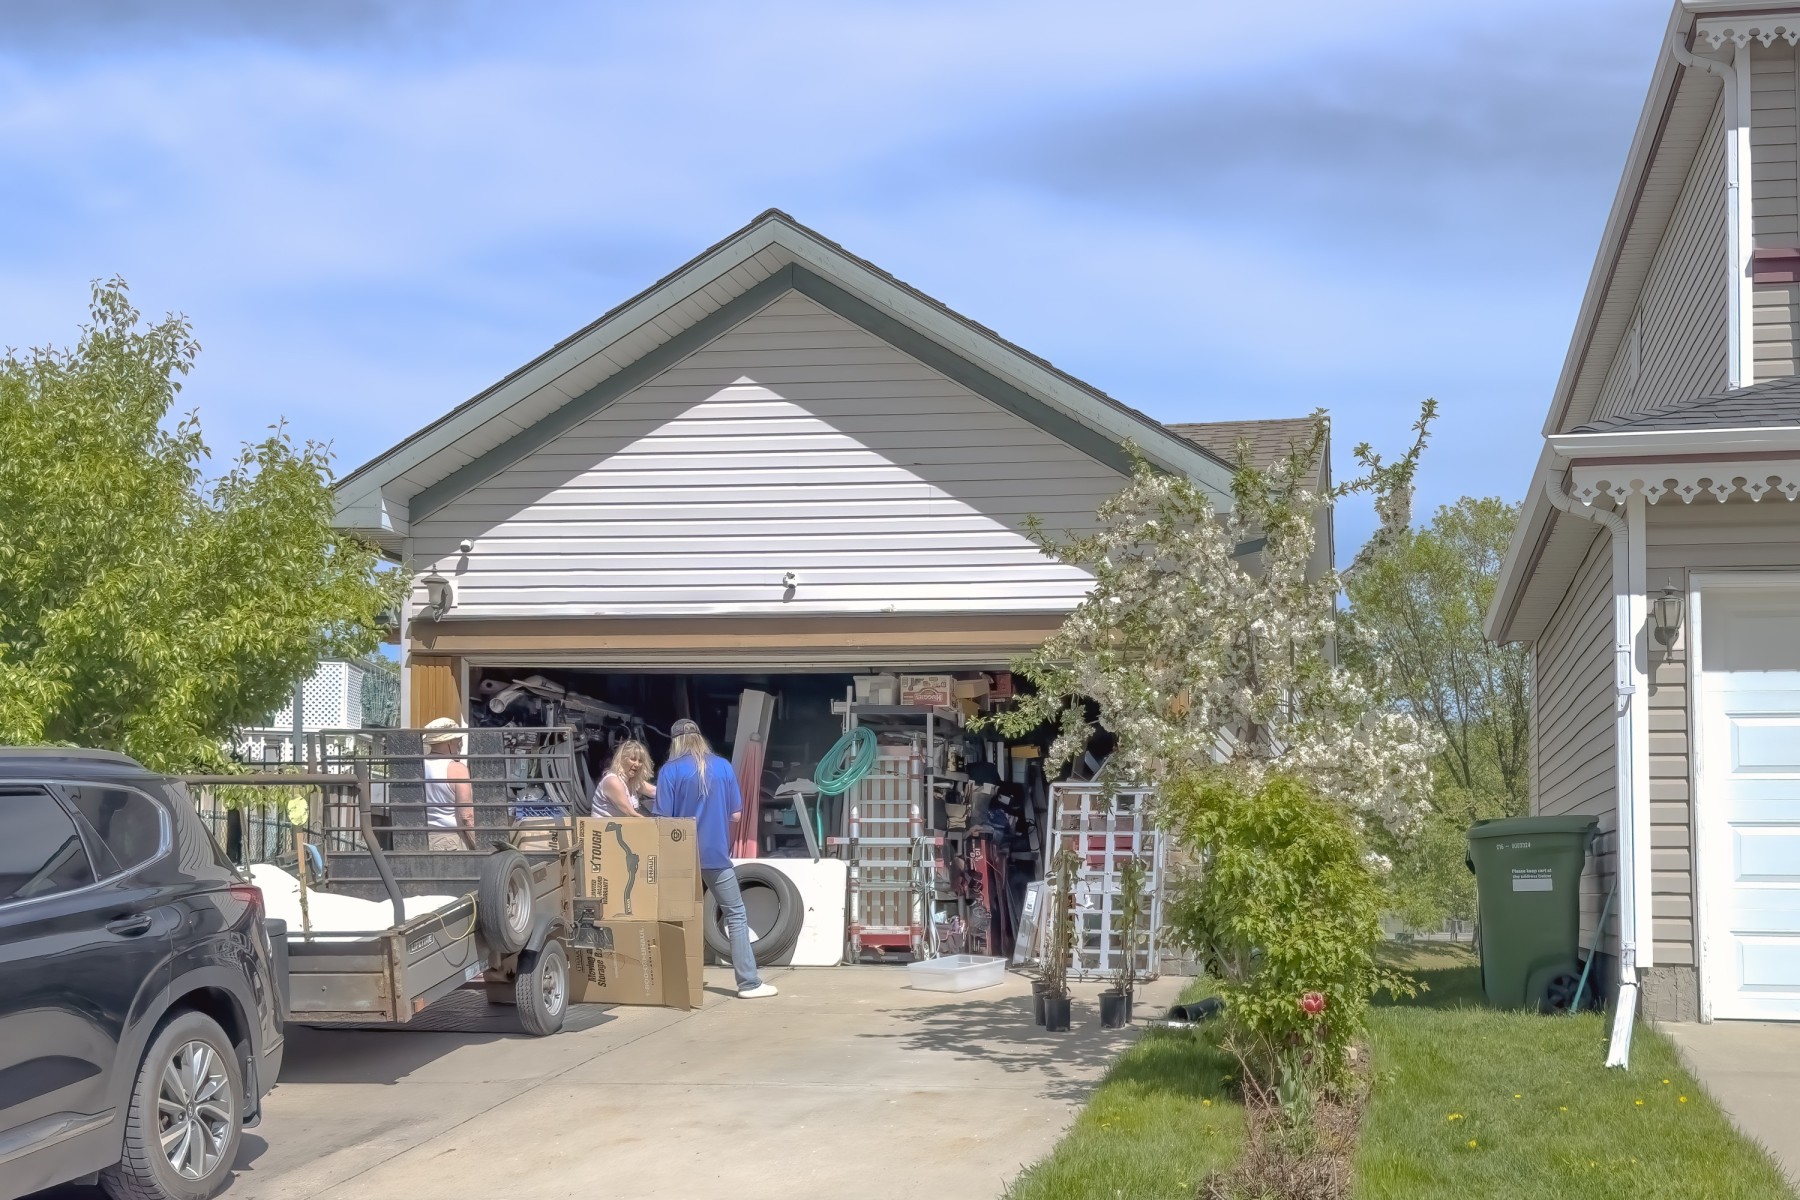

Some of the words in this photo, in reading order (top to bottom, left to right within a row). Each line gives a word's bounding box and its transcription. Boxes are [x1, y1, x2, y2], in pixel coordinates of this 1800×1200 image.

[591, 830, 602, 861] TOUGH
[586, 956, 597, 983] Moving
[597, 959, 607, 988] Storage
